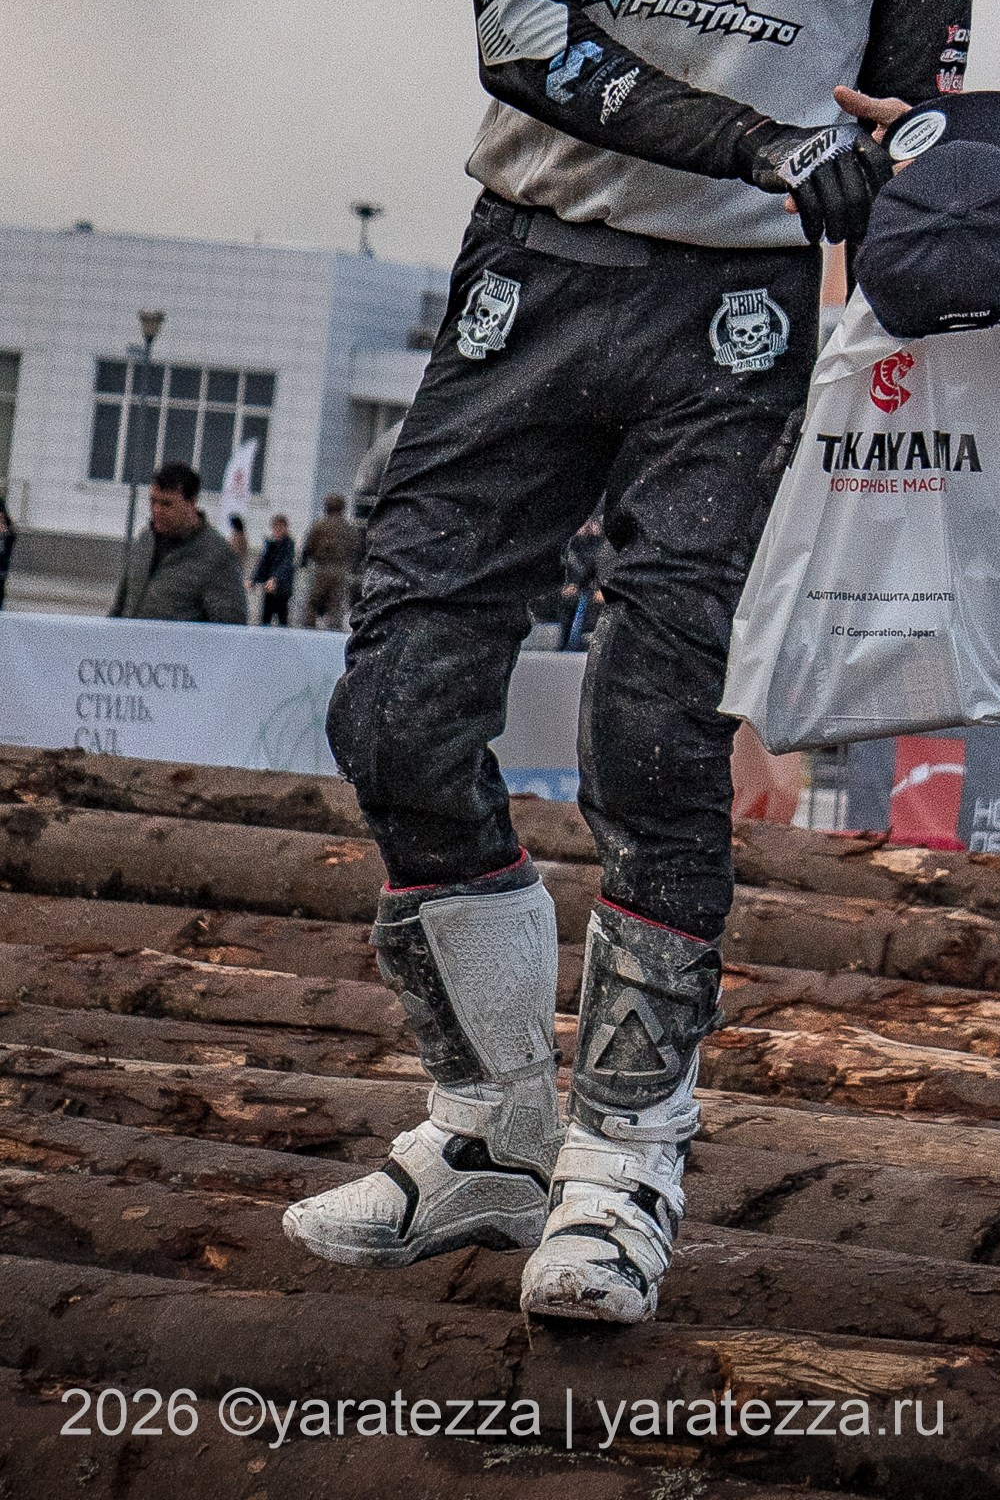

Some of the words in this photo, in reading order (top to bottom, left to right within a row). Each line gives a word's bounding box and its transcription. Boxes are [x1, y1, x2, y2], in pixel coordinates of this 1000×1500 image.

[867, 592, 909, 602] ЗАЩИТА
[830, 626, 844, 636] JCI
[847, 627, 906, 639] Corporation,
[907, 628, 935, 639] Japan
[78, 658, 197, 691] СКОРОСТЬ
